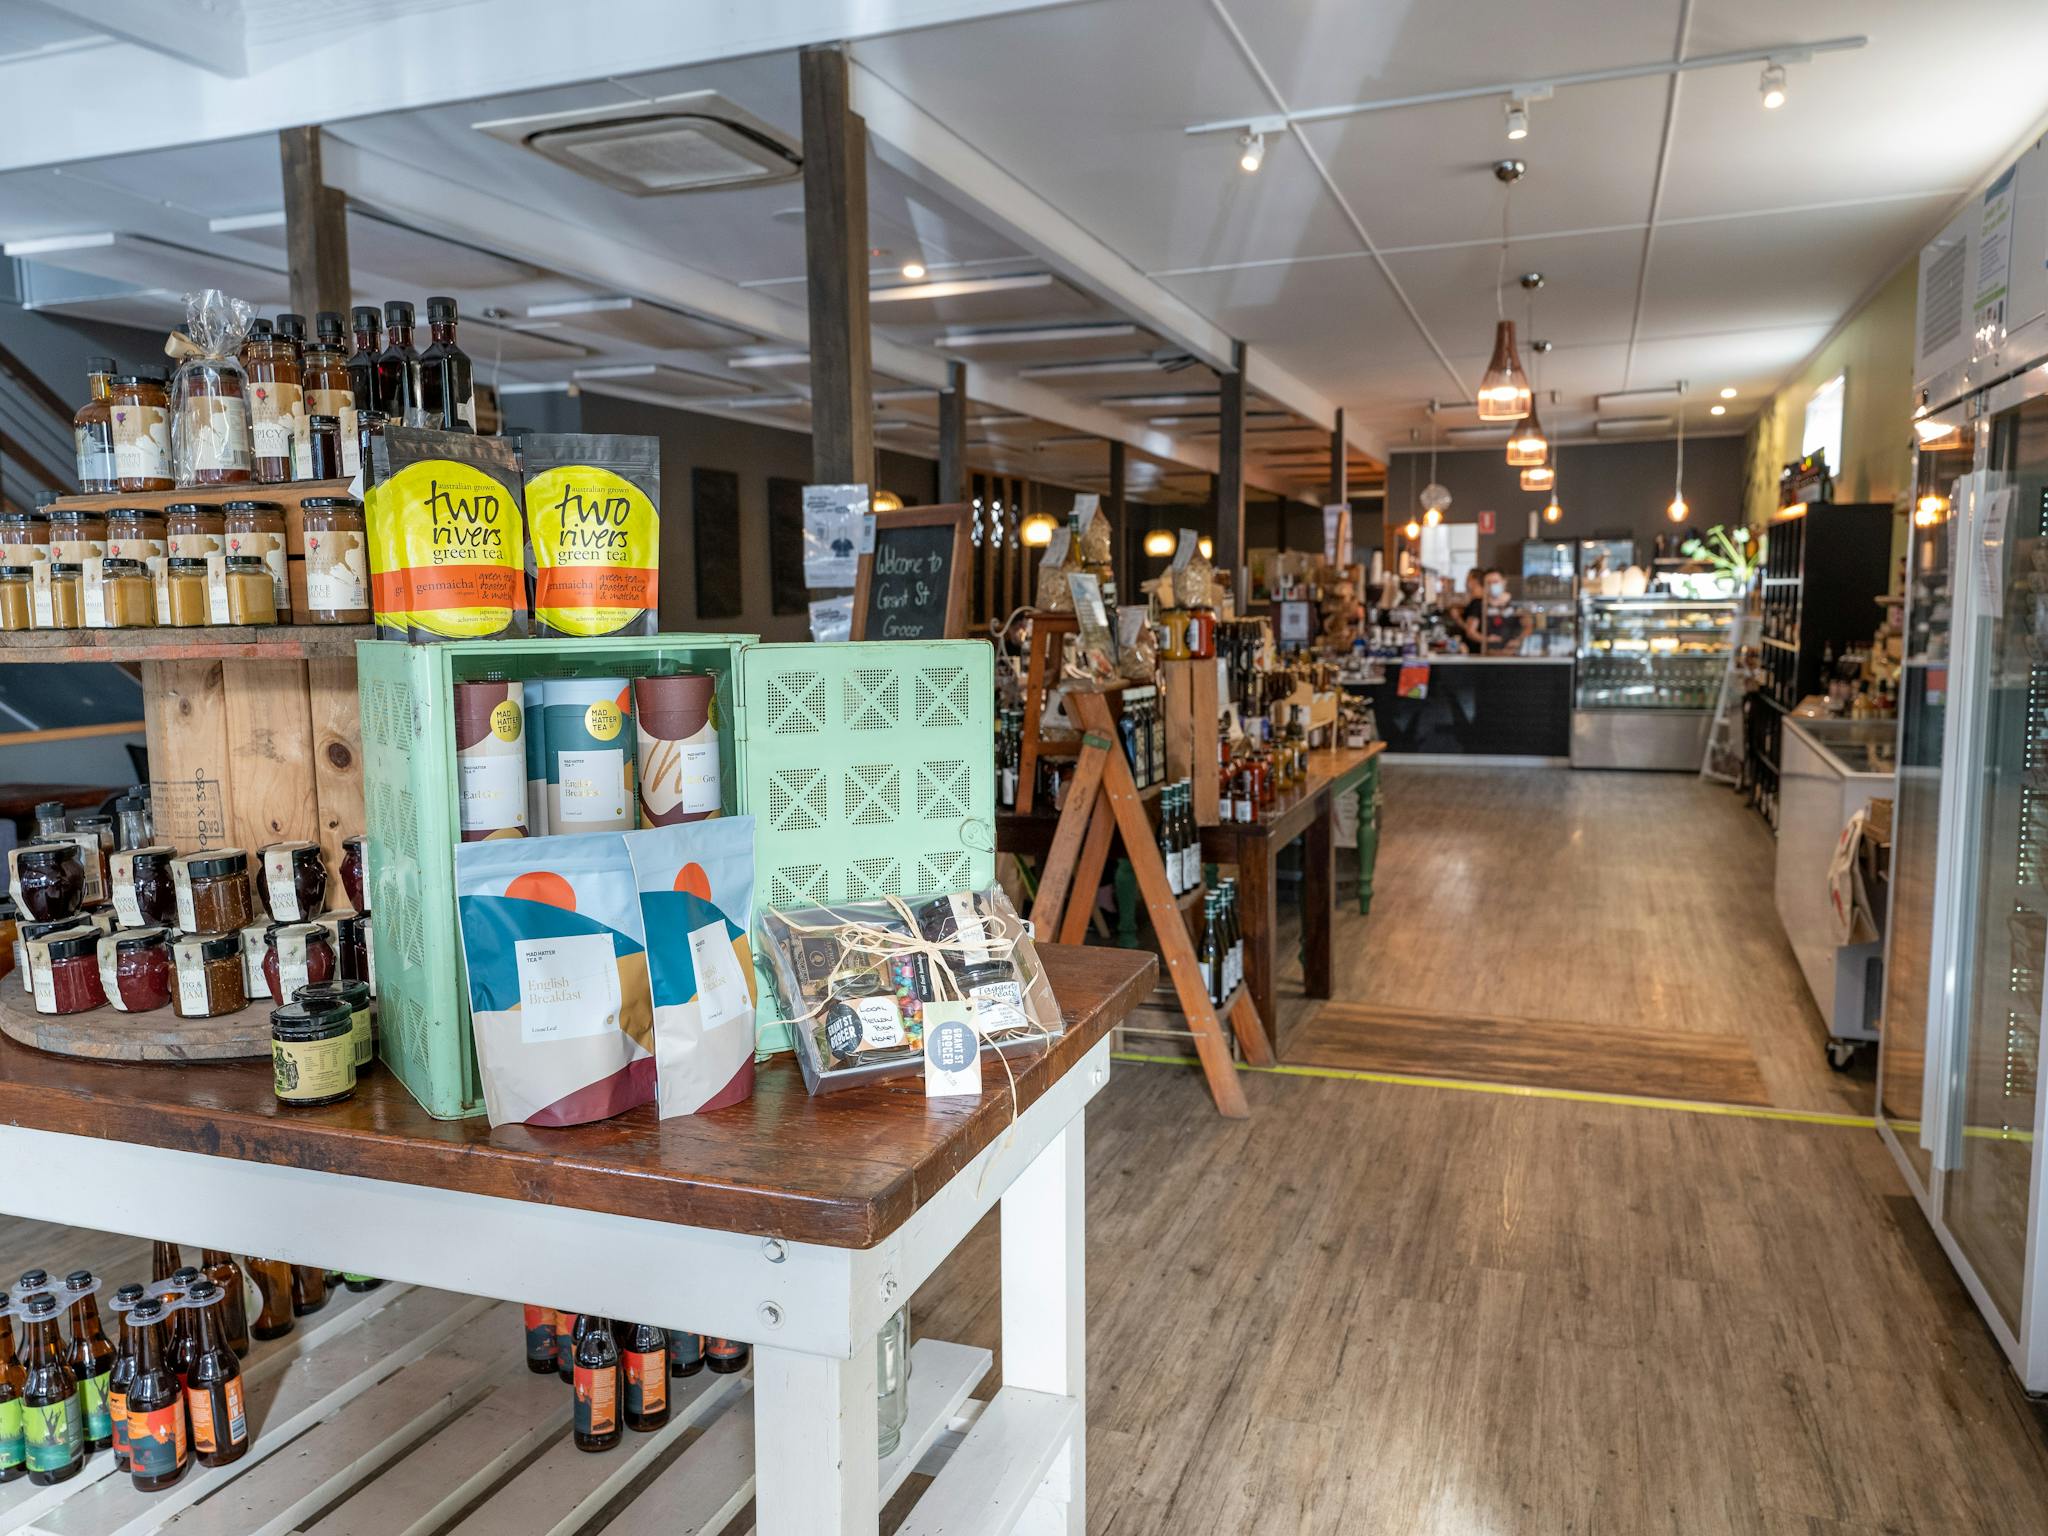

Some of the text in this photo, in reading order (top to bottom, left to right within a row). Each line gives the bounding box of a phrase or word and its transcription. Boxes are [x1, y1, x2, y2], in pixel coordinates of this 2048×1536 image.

[437, 482, 496, 492] australian grown
[571, 484, 630, 494] australian grown
[423, 480, 499, 525] two
[554, 483, 631, 528] two
[433, 520, 502, 547] rivers
[559, 523, 629, 549] rivers
[433, 549, 504, 564] green tea
[558, 549, 628, 565] green tea
[876, 545, 943, 575] Welcome to
[416, 578, 474, 594] genmaicha
[547, 578, 593, 590] enmaicha
[600, 573, 622, 583] green
[915, 581, 931, 605] St
[883, 615, 924, 637] Grocer
[496, 710, 512, 718] MAD
[497, 725, 512, 733] TEA
[538, 949, 556, 957] HATTER
[528, 975, 569, 993] English
[529, 989, 582, 1005] Breakfast
[827, 1014, 853, 1036] GRANT ST
[830, 1025, 857, 1049] GROCER
[953, 1027, 963, 1053] GRANT
[941, 1028, 954, 1065] GROCER
